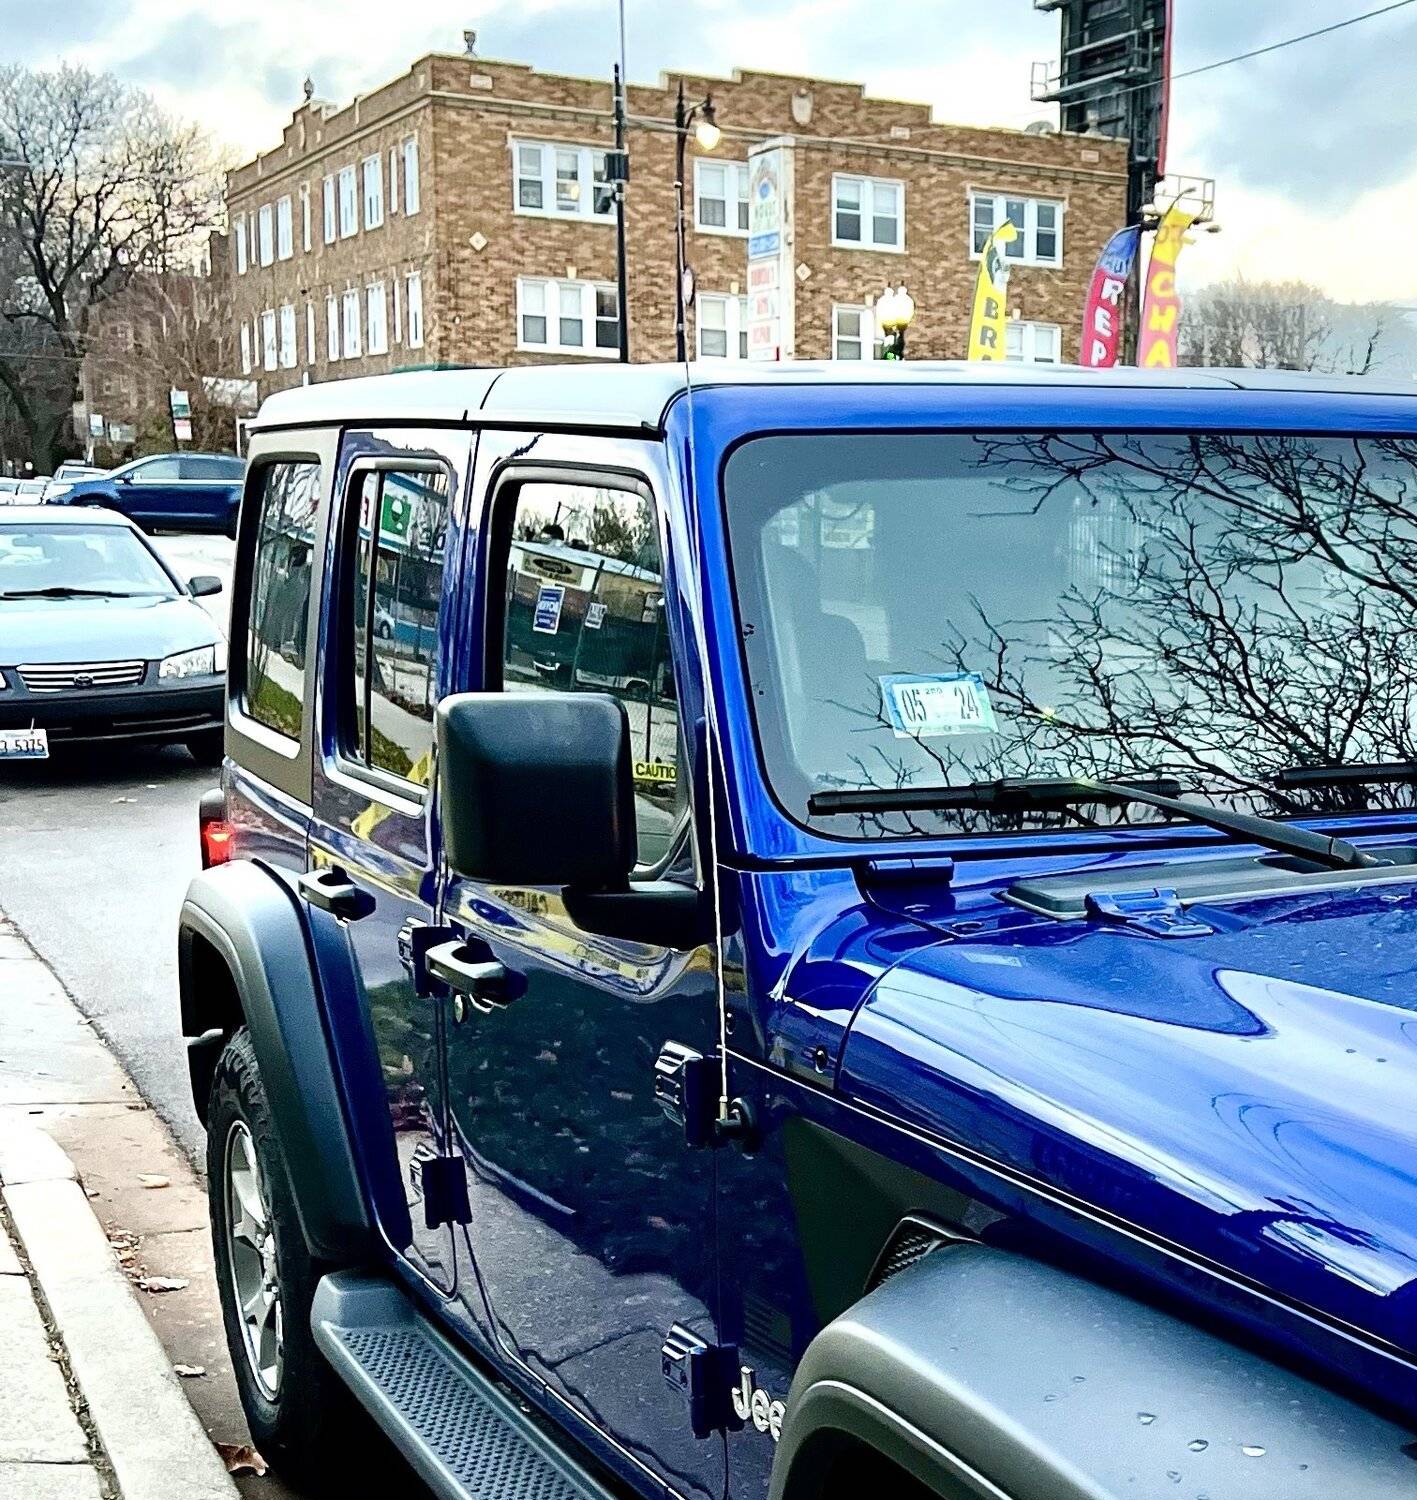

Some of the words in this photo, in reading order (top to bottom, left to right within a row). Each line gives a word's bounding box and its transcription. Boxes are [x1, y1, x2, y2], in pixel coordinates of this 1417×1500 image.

[1090, 278, 1125, 368] REP
[901, 689, 927, 722] 05
[954, 685, 981, 720] 24
